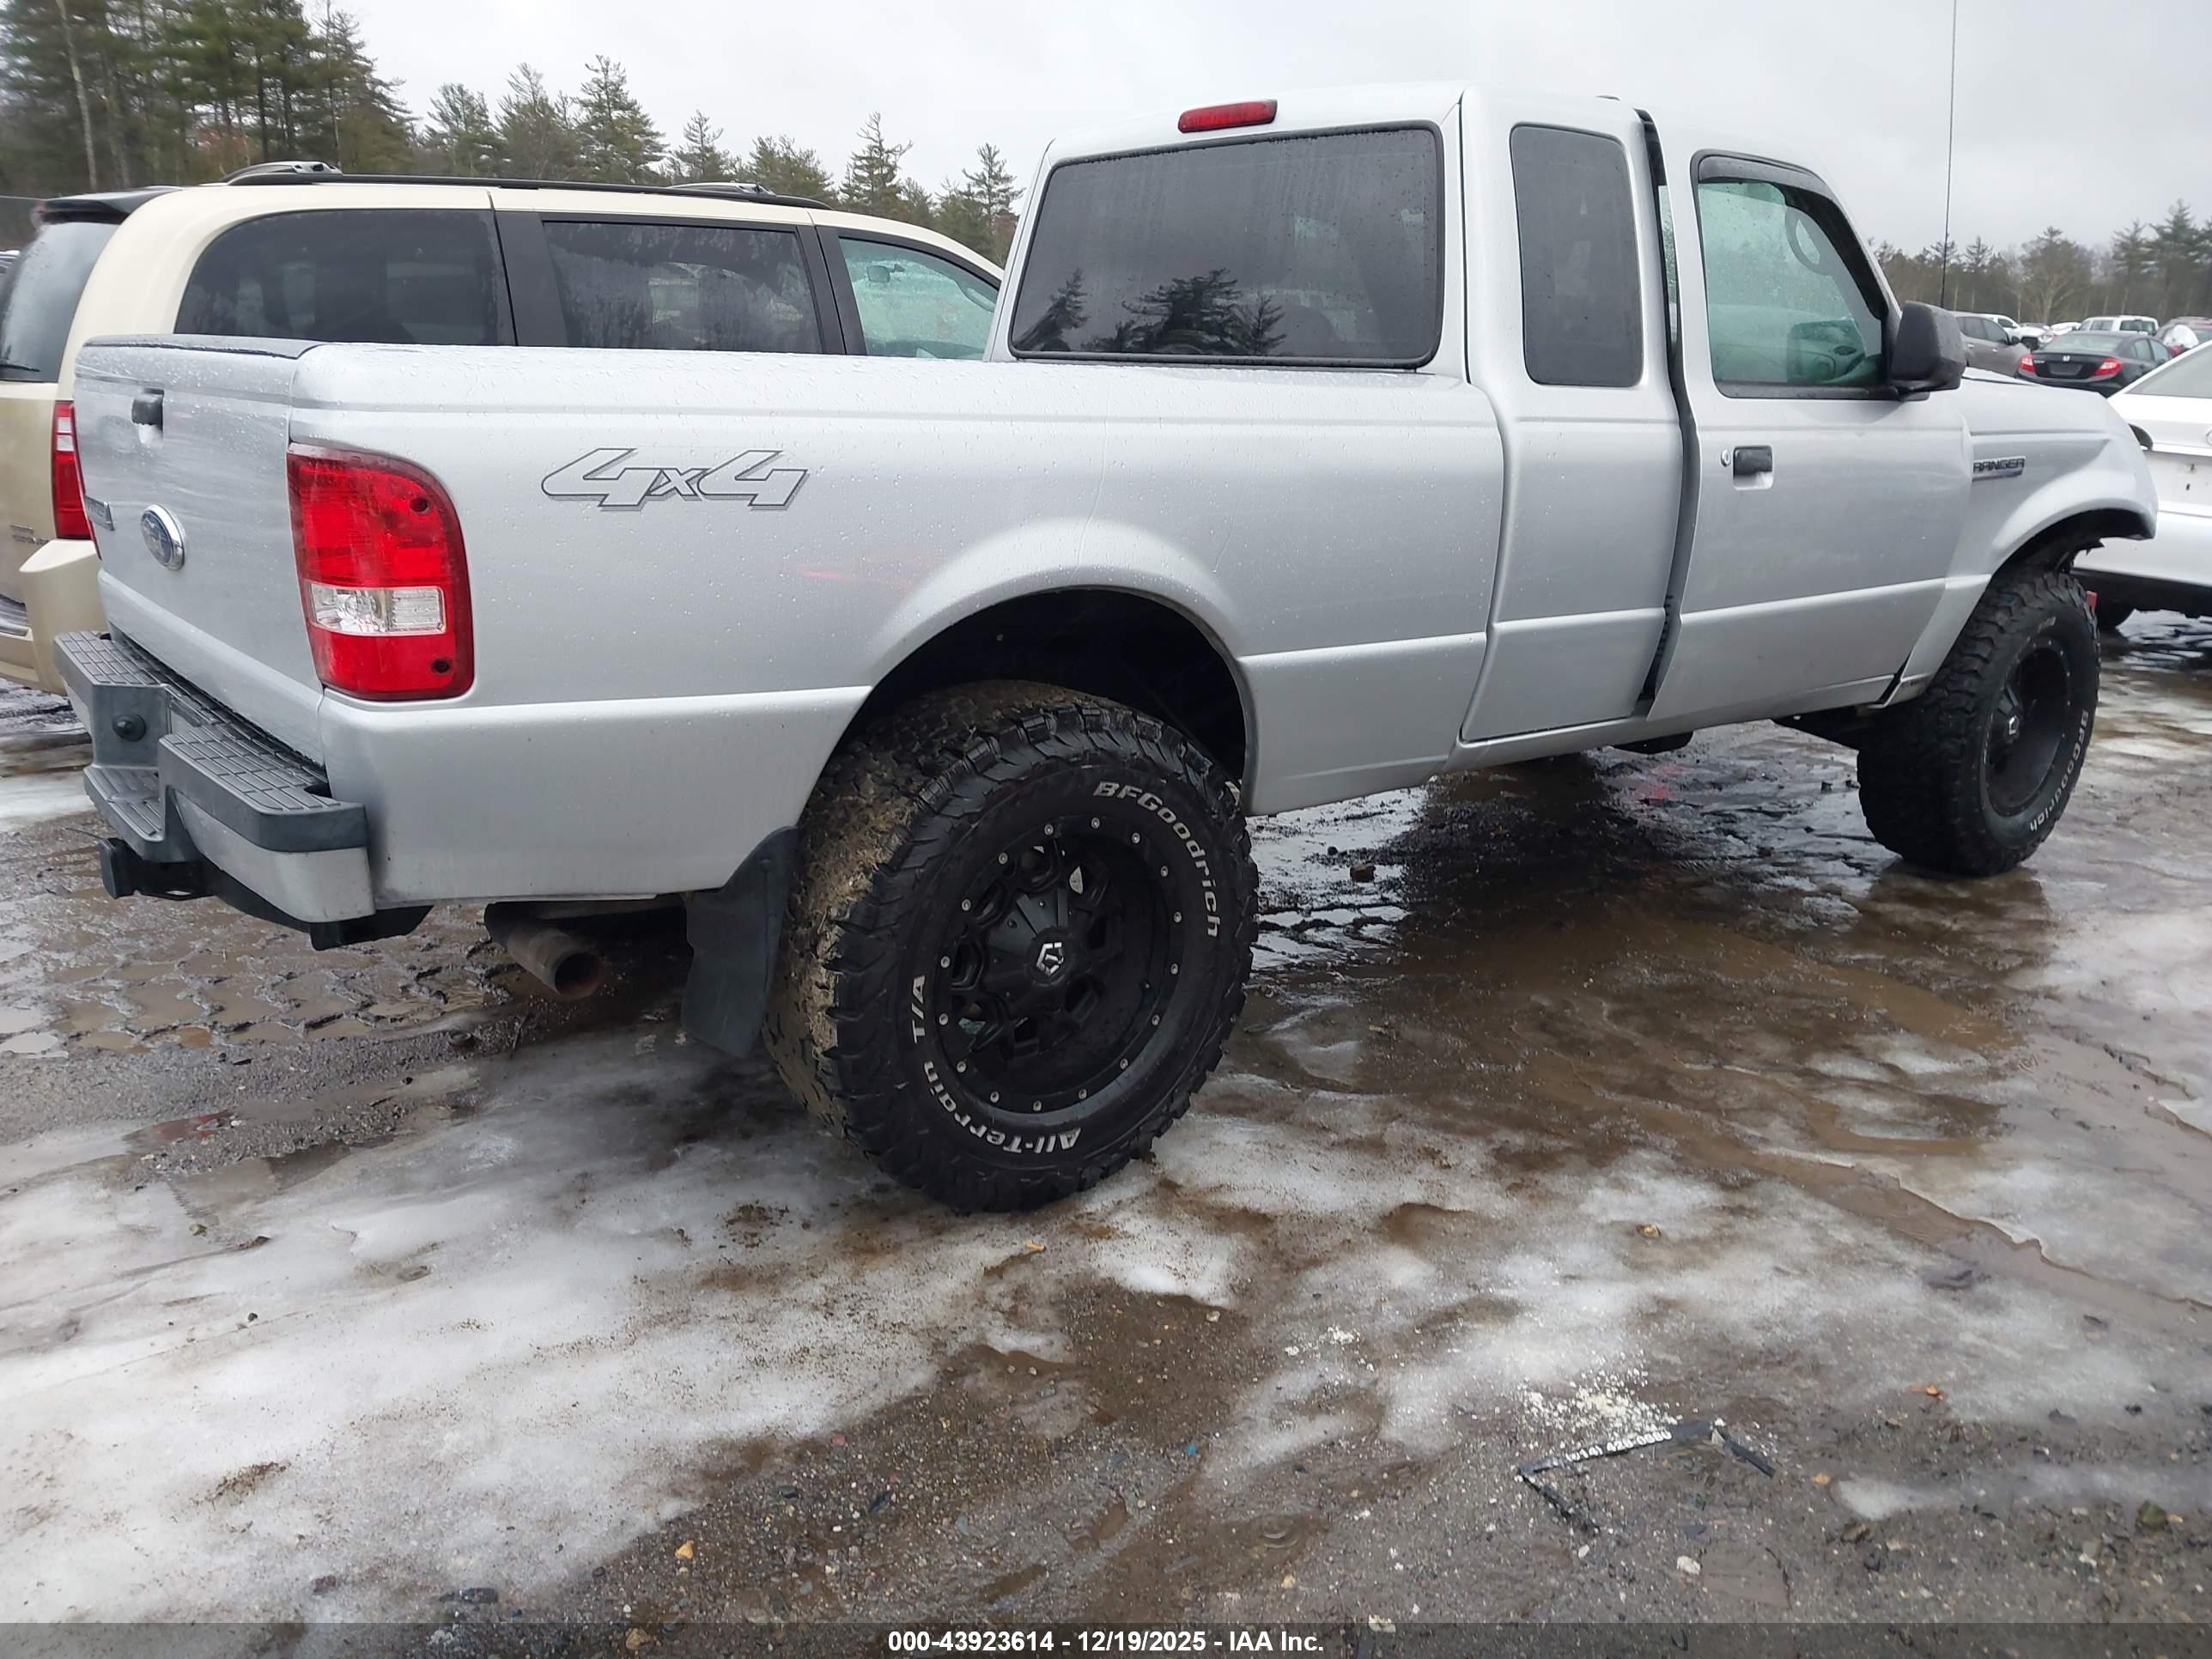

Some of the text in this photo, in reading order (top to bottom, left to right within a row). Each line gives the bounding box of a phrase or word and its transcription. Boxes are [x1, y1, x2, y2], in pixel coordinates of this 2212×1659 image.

[541, 447, 809, 510] 4x4
[1972, 458, 2025, 474] RANGER
[1093, 781, 1220, 937] BFGoodrich
[911, 975, 1082, 1154] All-Terrain T/A
